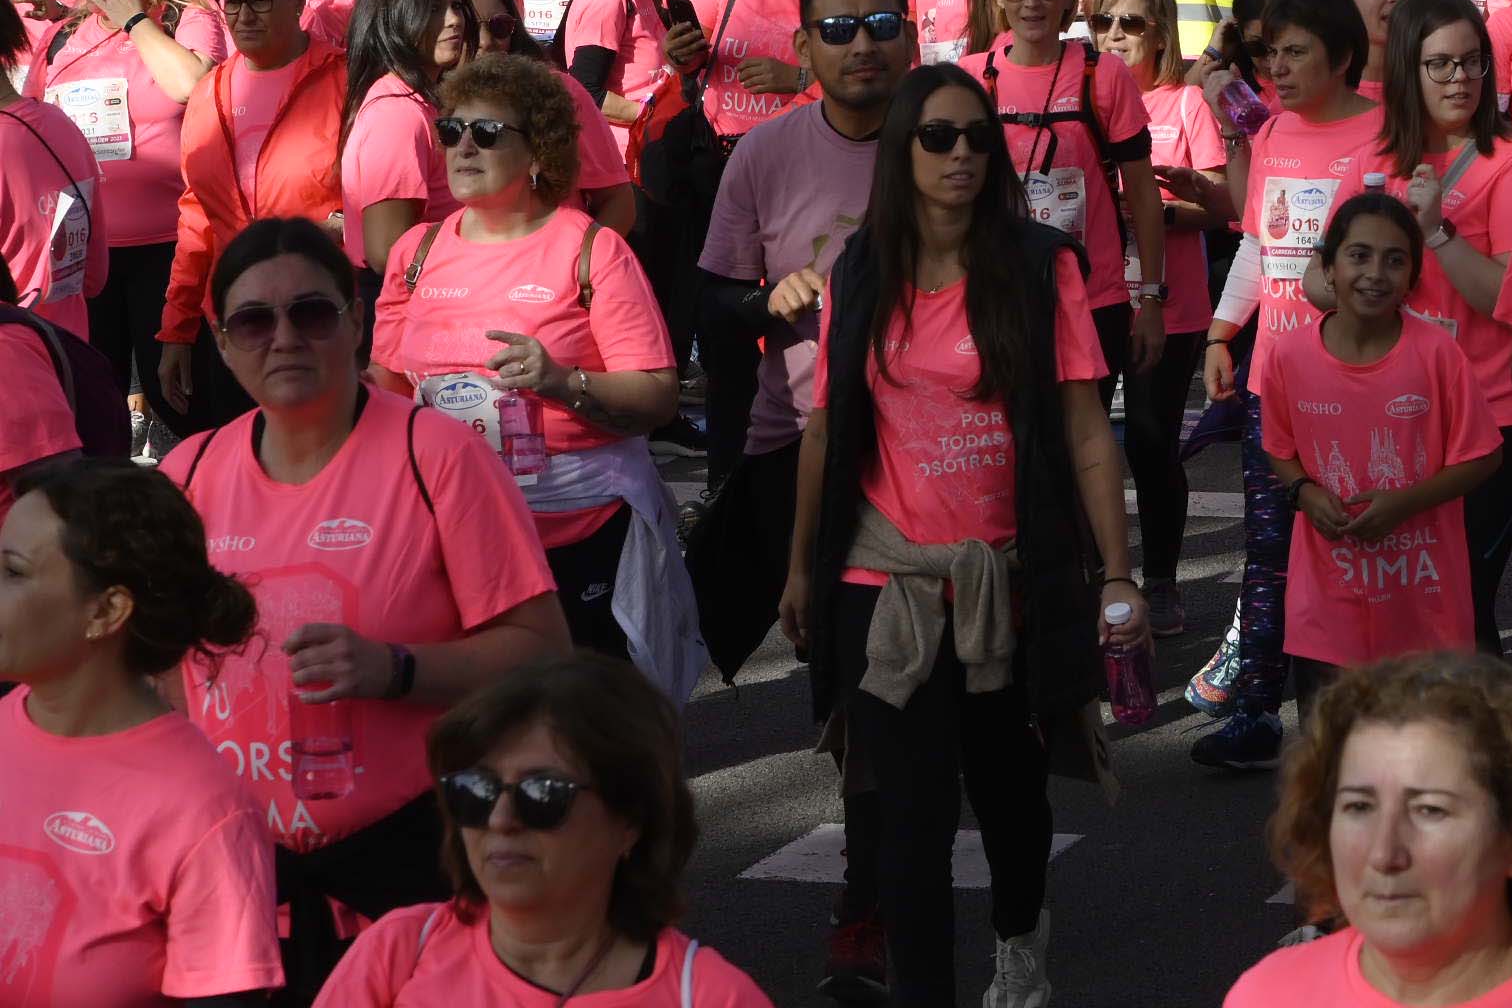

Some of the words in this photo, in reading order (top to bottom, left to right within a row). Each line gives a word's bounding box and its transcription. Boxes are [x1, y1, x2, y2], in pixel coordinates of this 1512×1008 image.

[726, 38, 749, 58] TU
[1263, 157, 1301, 169] OYSHO
[1292, 218, 1319, 232] 016
[1267, 262, 1297, 271] OYSHO
[421, 288, 469, 299] OYSHO
[439, 393, 483, 405] ASTURIANA
[1298, 399, 1342, 416] OYSHO
[961, 412, 1003, 428] POR
[938, 432, 1005, 451] TODAS
[310, 532, 370, 544] ASTURIANA
[49, 818, 108, 851] ASTURIANA
